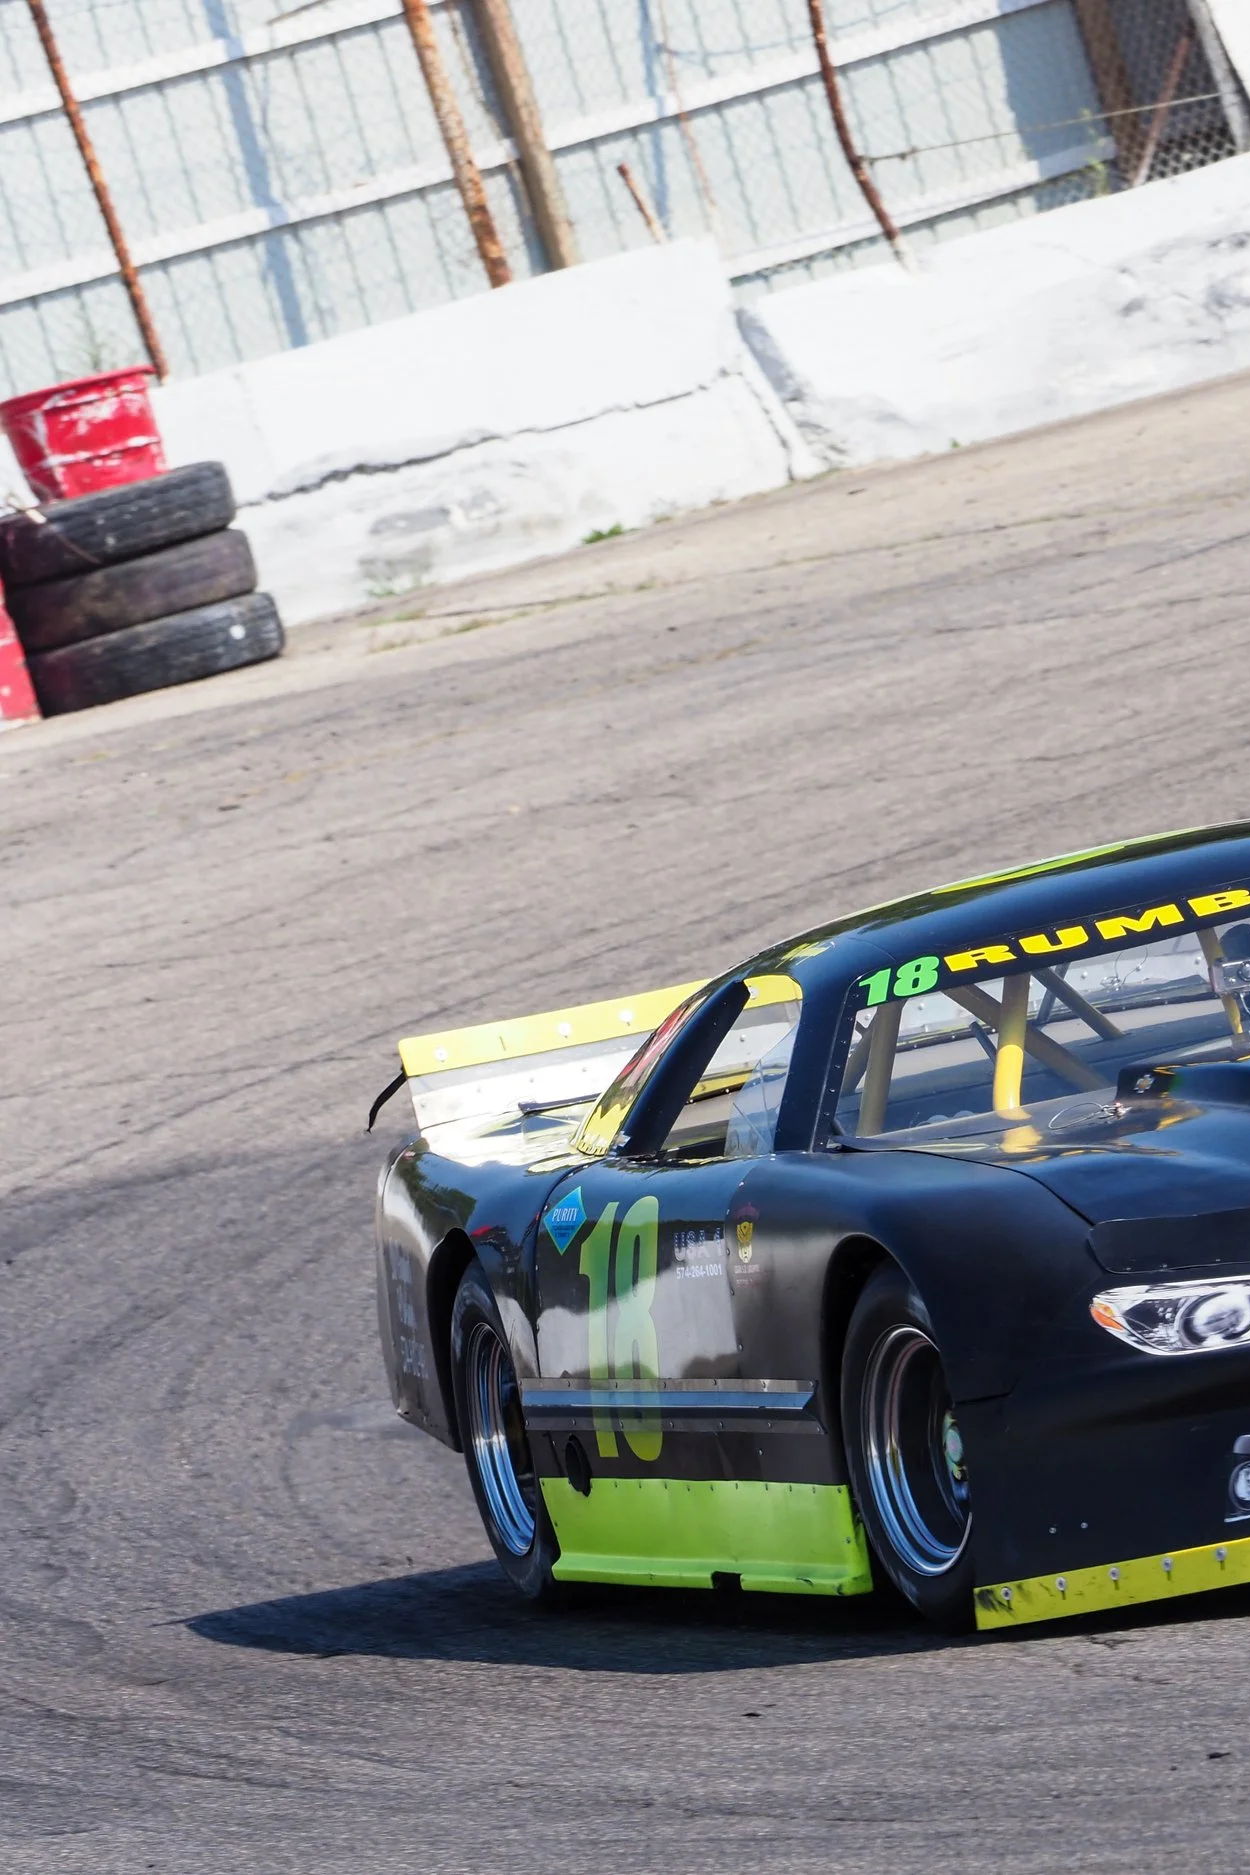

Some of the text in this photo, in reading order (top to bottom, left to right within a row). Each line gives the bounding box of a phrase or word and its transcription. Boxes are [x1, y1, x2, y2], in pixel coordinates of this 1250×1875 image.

[858, 955, 939, 1006] 18
[551, 1207, 579, 1222] PURITY
[676, 1263, 723, 1279] 574-264-1001
[579, 1195, 663, 1462] 18
